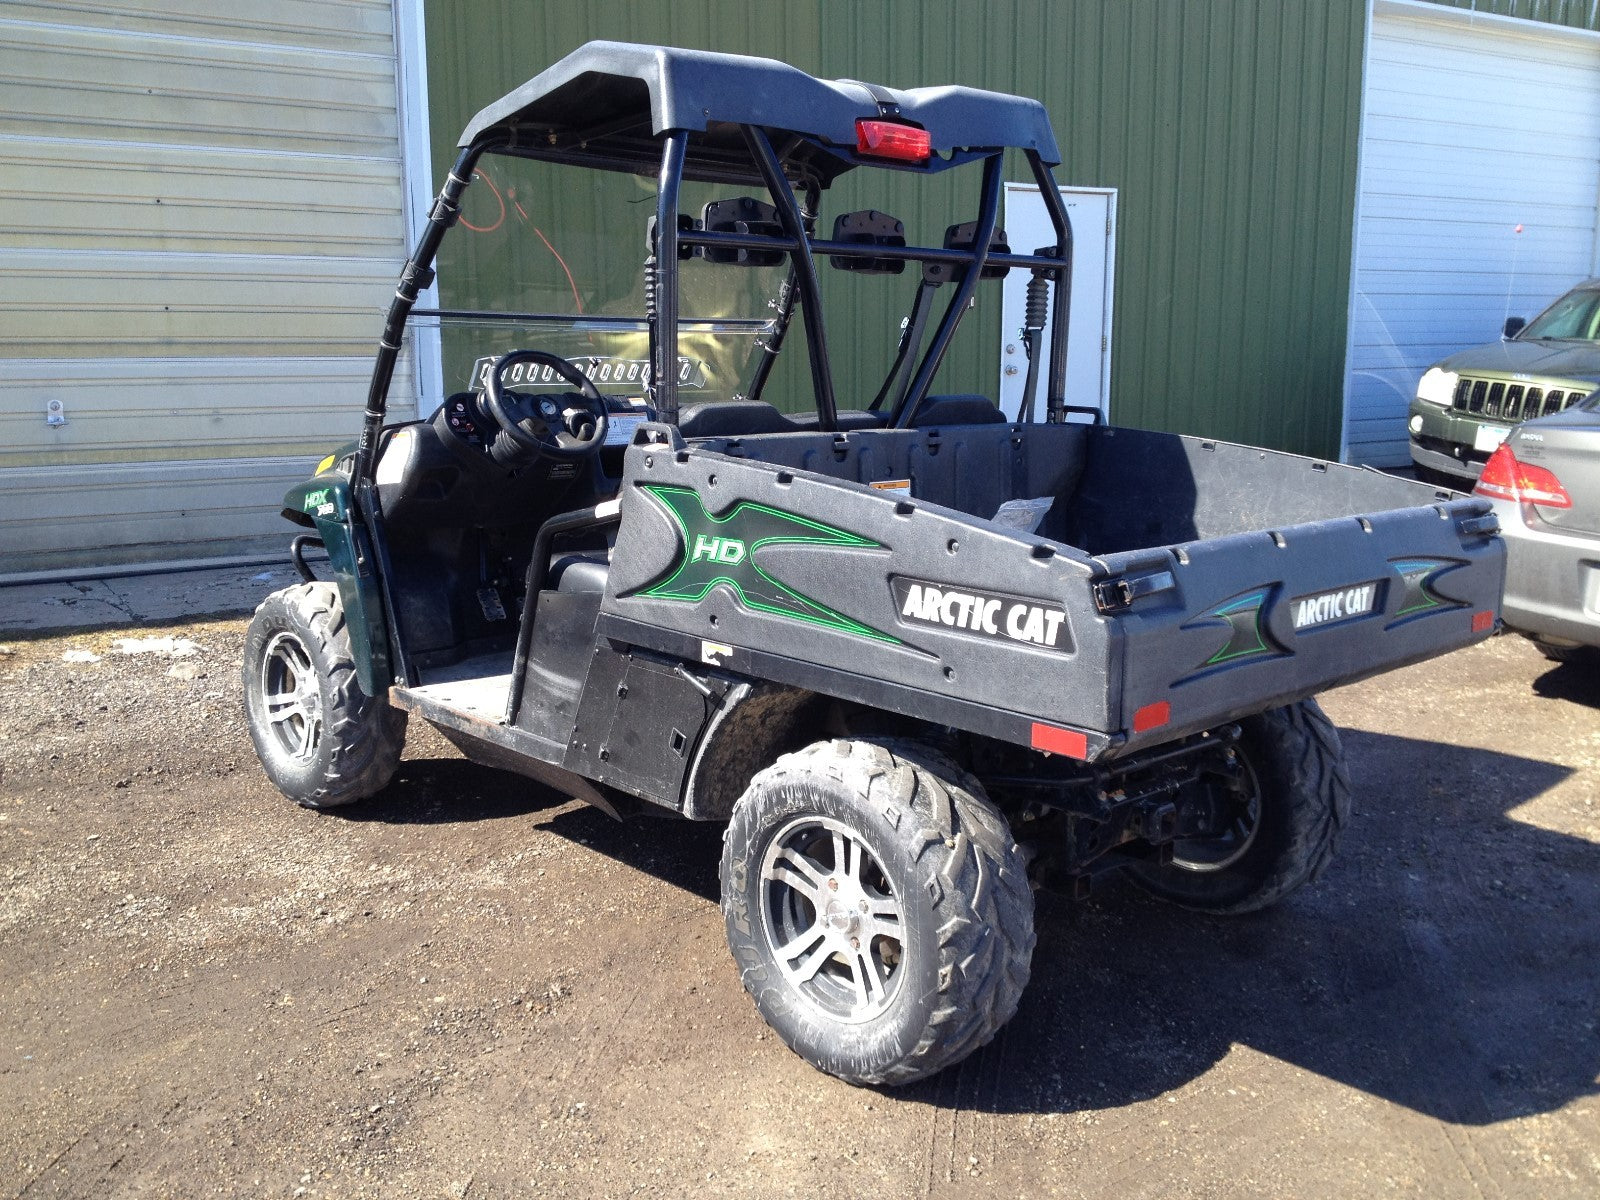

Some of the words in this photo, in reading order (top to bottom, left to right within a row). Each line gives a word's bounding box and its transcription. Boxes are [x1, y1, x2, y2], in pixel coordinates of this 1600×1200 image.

[691, 534, 746, 566] HD
[902, 584, 1002, 635] ARCTIC
[1006, 604, 1065, 646] CAT
[1296, 591, 1343, 628] ARCTIC
[1345, 586, 1370, 615] CAT
